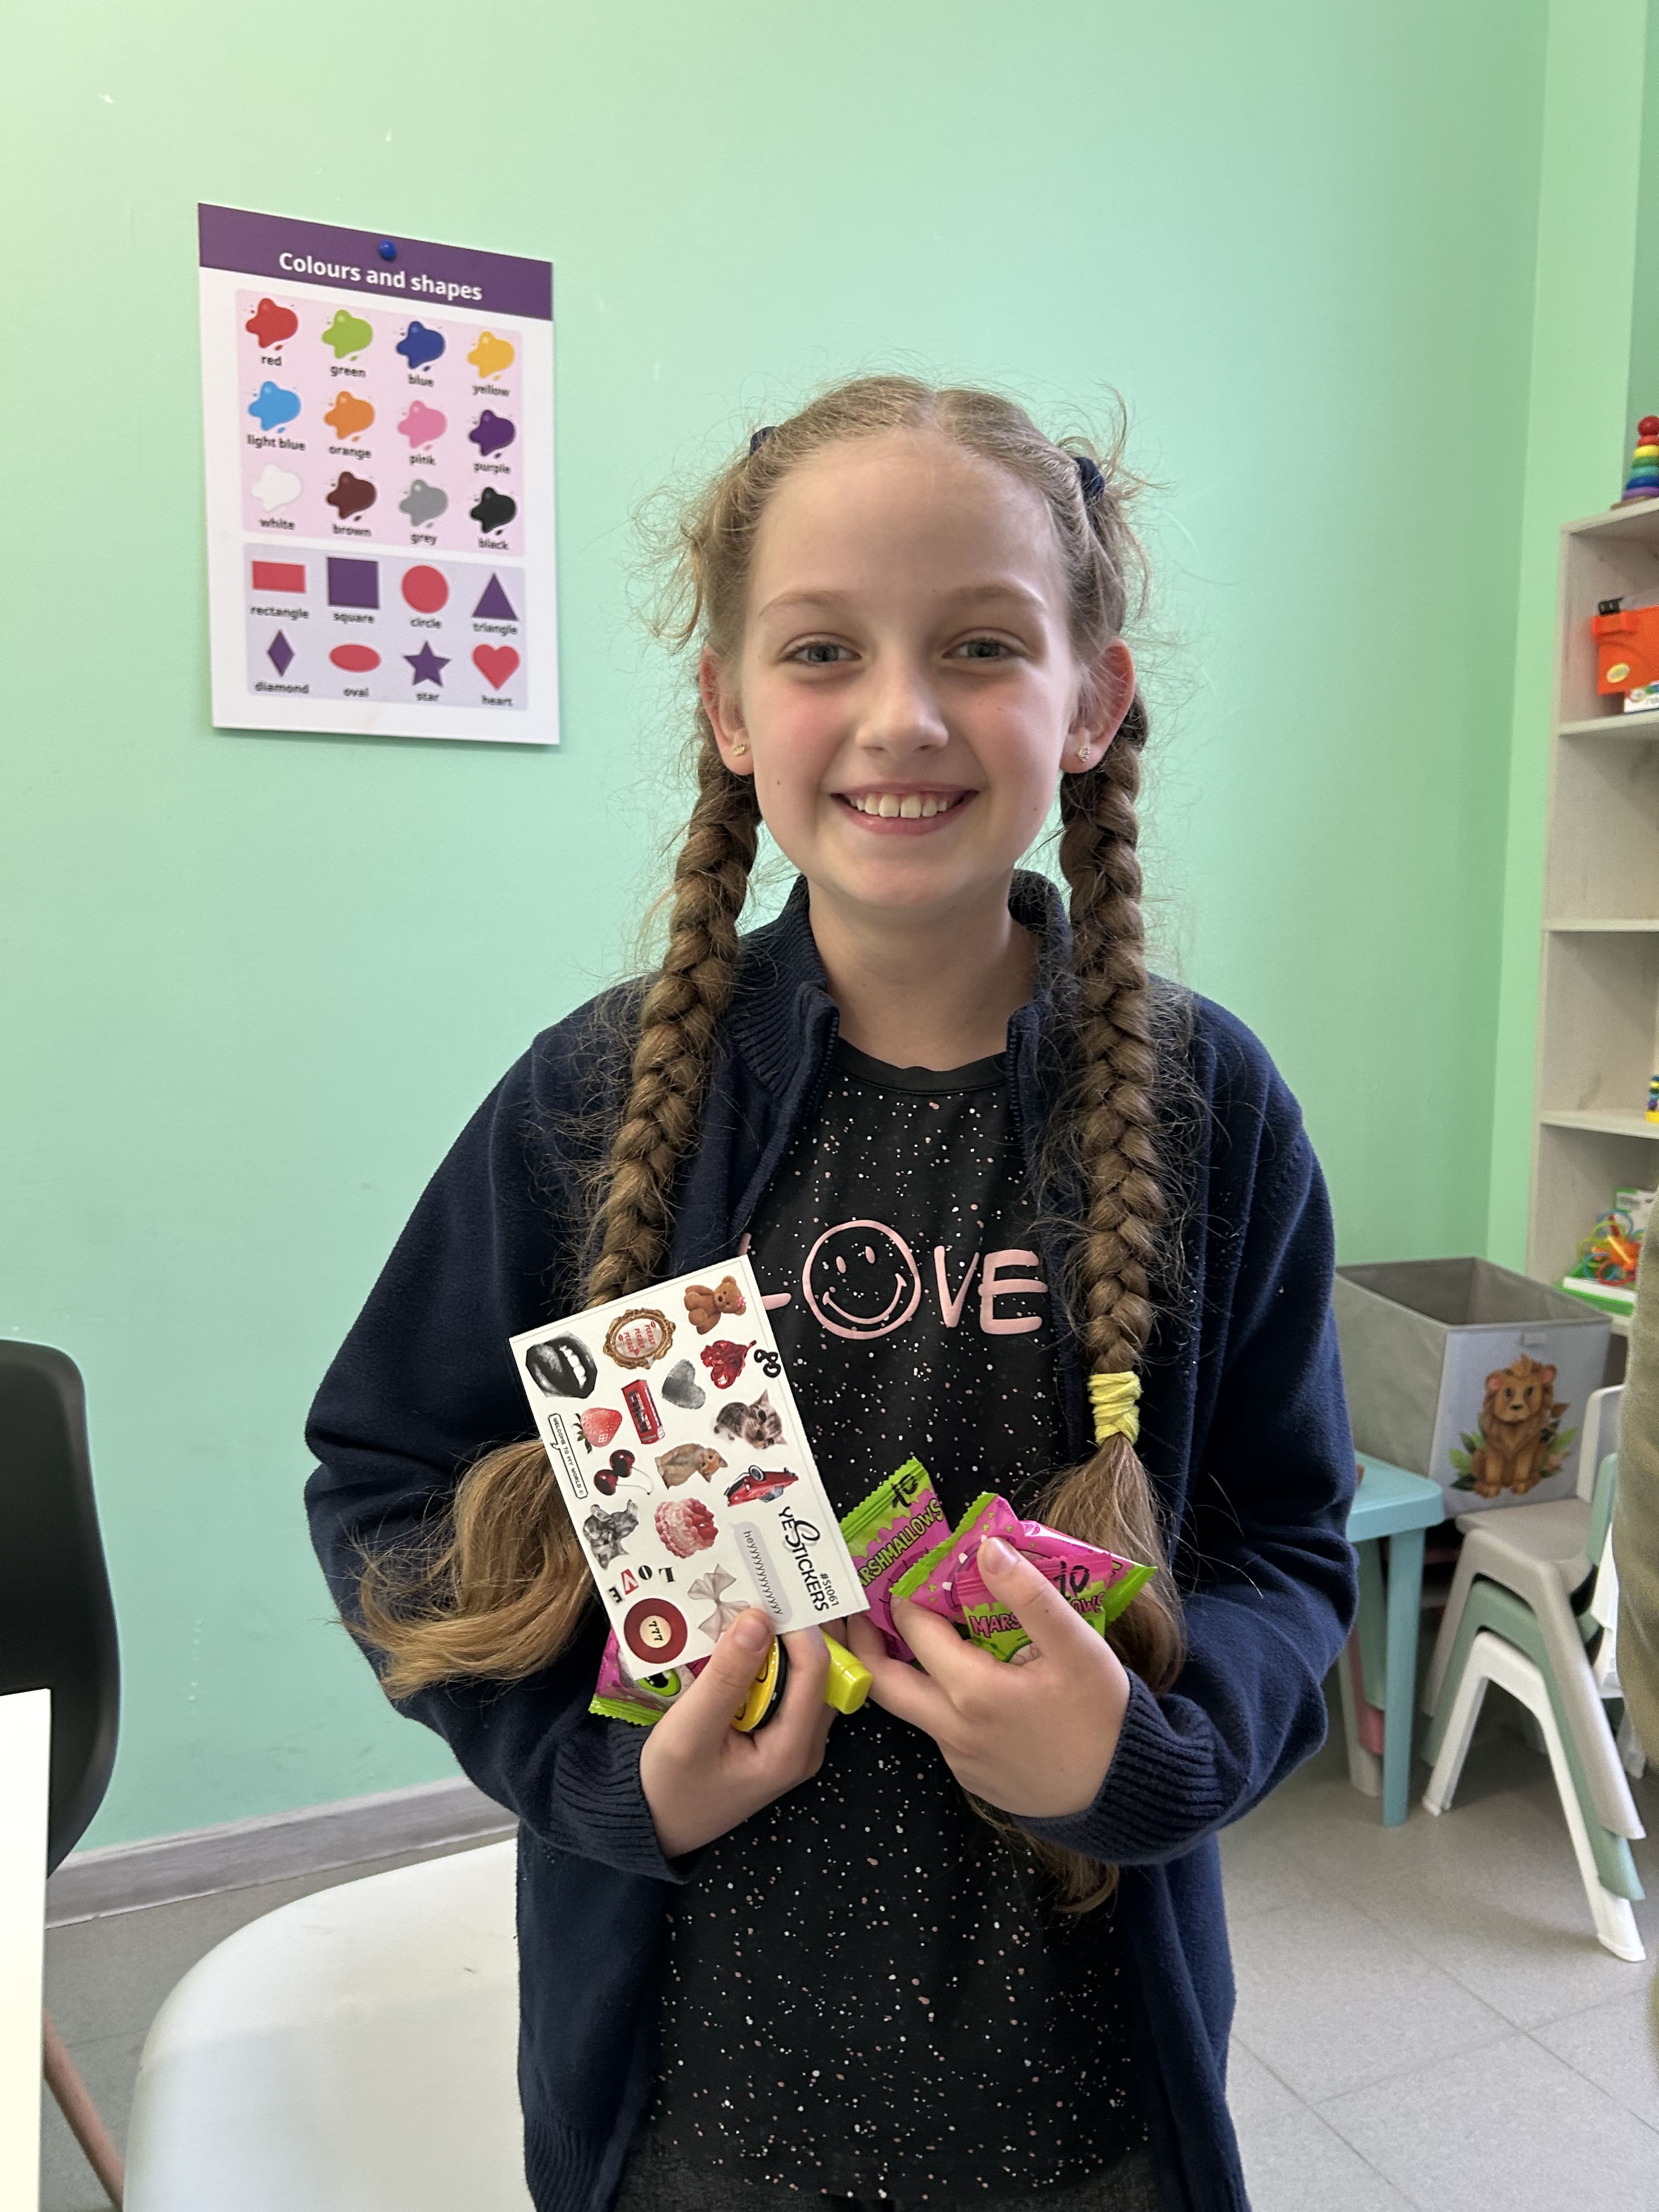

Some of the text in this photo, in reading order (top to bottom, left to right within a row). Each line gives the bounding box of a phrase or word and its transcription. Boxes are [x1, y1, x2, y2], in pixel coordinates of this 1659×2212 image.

[278, 252, 483, 301] Colours and shapes
[261, 356, 282, 366] red
[330, 365, 366, 378] green
[408, 374, 435, 387] blue
[472, 384, 510, 397] yellow
[246, 433, 306, 451] light blue
[328, 445, 372, 460] orange
[409, 454, 436, 466] pink
[473, 462, 511, 475] purple
[259, 517, 295, 531] white
[332, 523, 372, 537] brown
[410, 533, 438, 546] grey
[478, 538, 509, 551] black
[250, 606, 309, 621] rectangle
[333, 612, 375, 624] square
[409, 617, 442, 629] circle
[472, 622, 518, 636] triangle
[254, 681, 309, 695] diamond
[343, 687, 369, 698] oval
[415, 692, 440, 703] star
[481, 695, 513, 707] heart
[644, 1324, 656, 1345] PLEASE
[553, 1417, 582, 1489] WELCOME TO MY WORLD
[857, 1498, 944, 1587] RSHMALLOWS
[820, 1573, 839, 1606] #St061
[648, 1620, 664, 1641] 777
